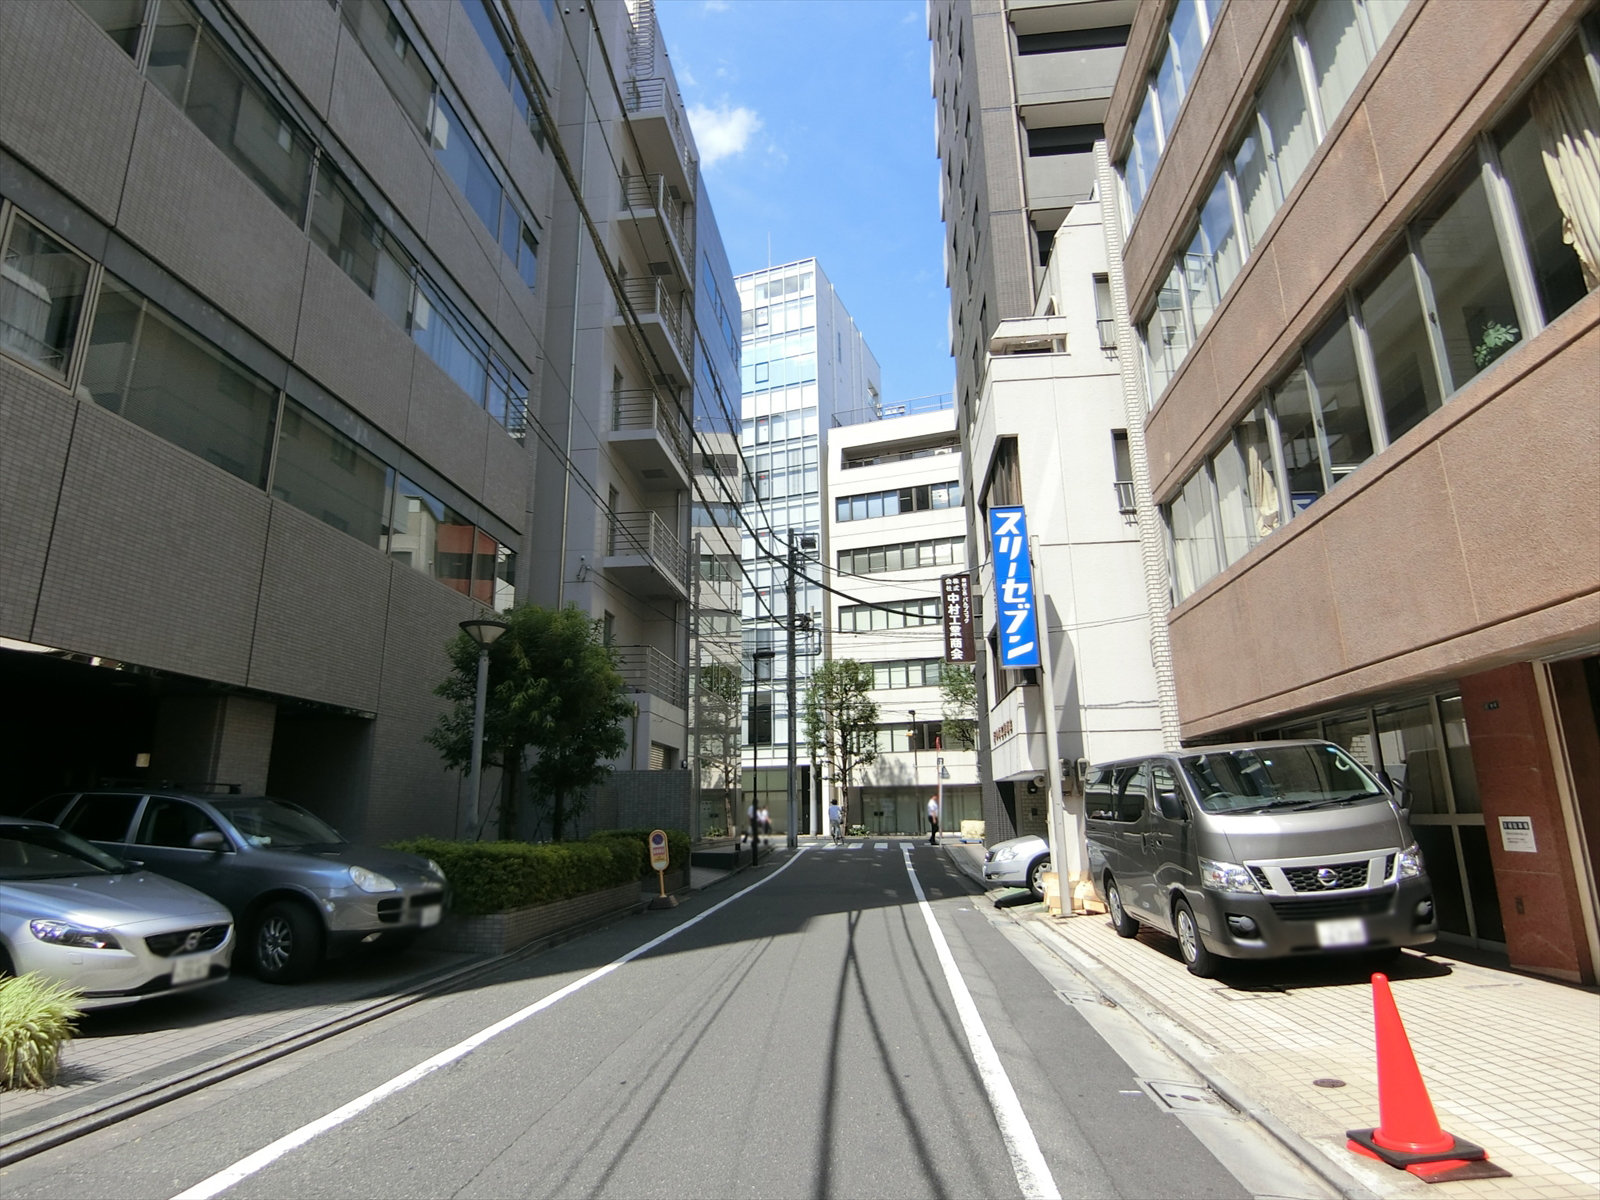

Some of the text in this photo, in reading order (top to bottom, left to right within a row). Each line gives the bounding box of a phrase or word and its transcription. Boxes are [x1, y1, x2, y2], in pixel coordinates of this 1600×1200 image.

[994, 512, 1034, 660] スリーセブン
